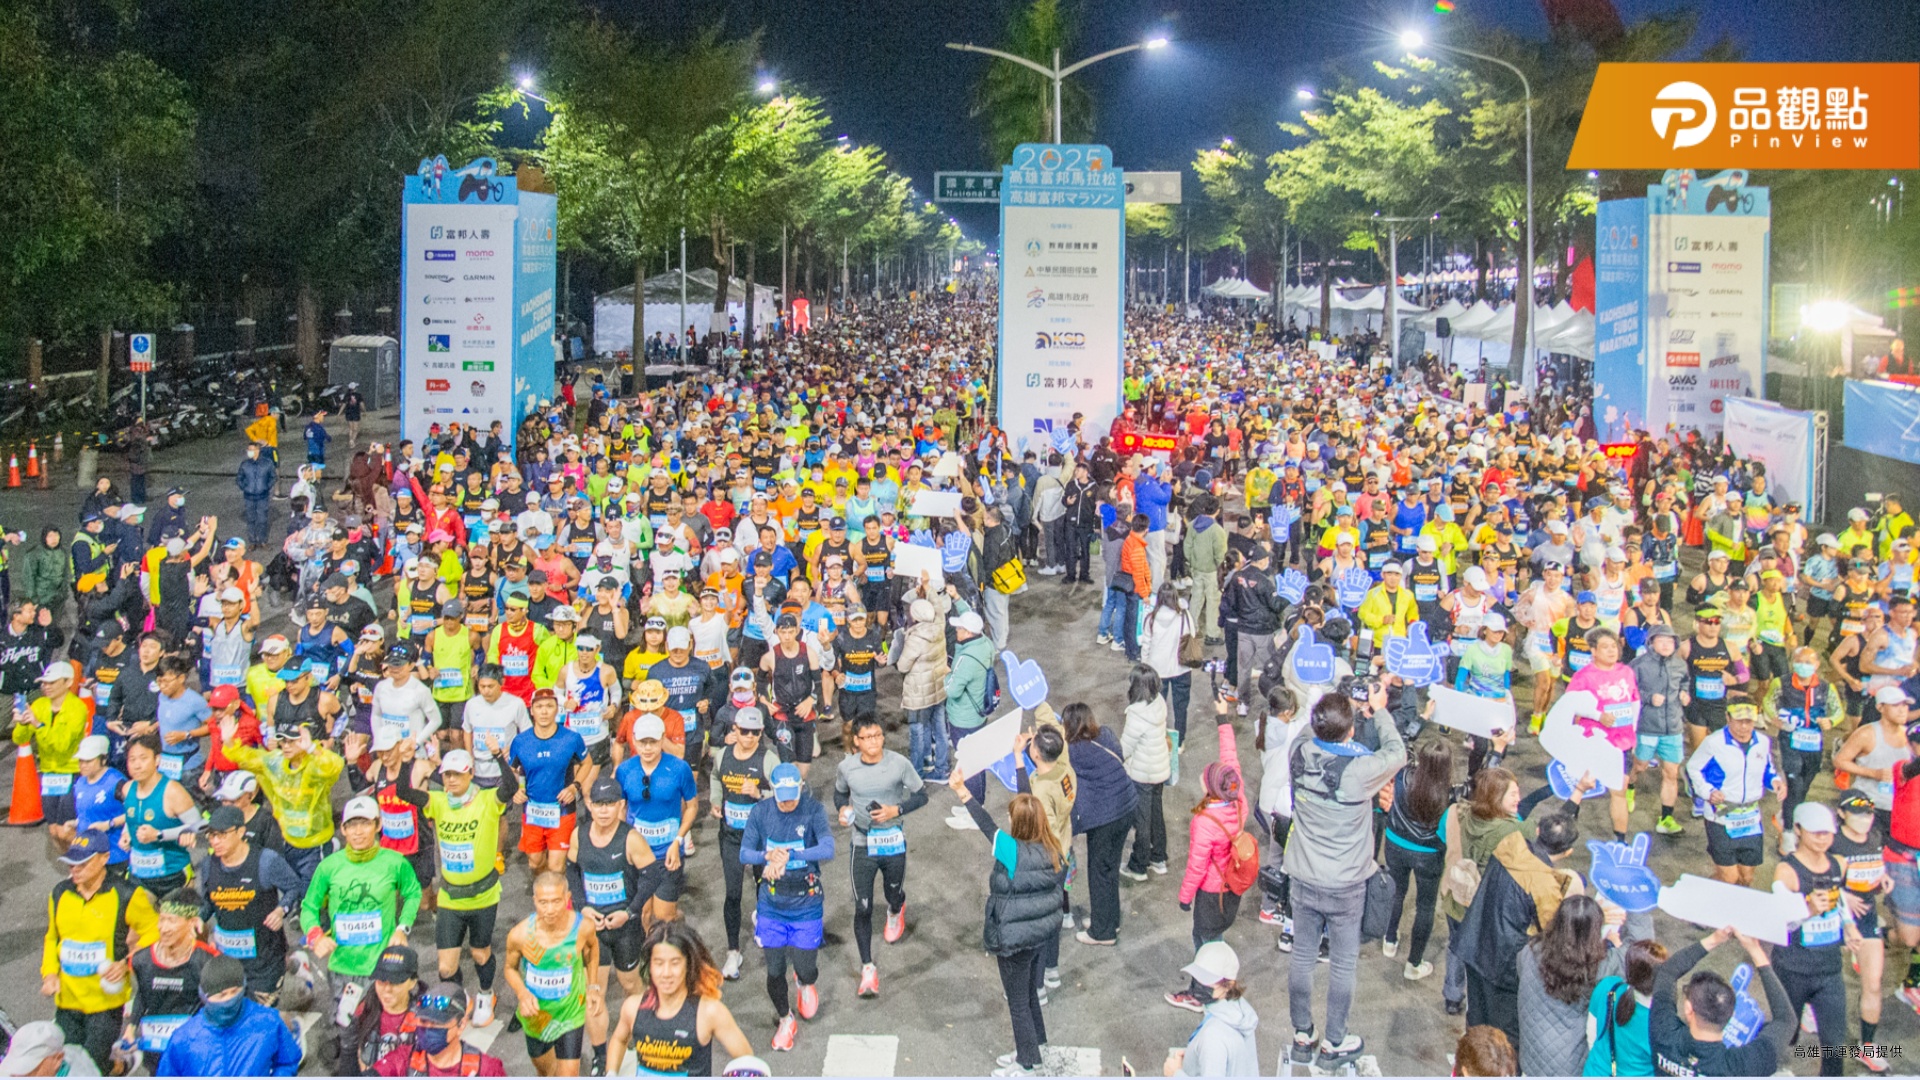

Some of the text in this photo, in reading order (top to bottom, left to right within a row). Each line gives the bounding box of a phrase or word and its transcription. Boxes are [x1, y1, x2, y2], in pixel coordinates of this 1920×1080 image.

[1019, 147, 1103, 172] 2025
[1010, 170, 1116, 187] 高雄富邦馬拉松
[946, 189, 986, 198] National
[1010, 190, 1115, 206] 高雄富邦マラソン
[446, 229, 490, 240] 富邦人壽
[1711, 262, 1742, 270] momo
[1052, 331, 1086, 346] KSD
[1043, 377, 1094, 390] 富邦人壽
[671, 677, 692, 687] 2021
[639, 826, 666, 836] 10819
[873, 835, 899, 845] 13087
[443, 850, 468, 862] 12243
[588, 881, 618, 892] 10756
[342, 920, 375, 932] 10484
[532, 975, 565, 987] 11404
